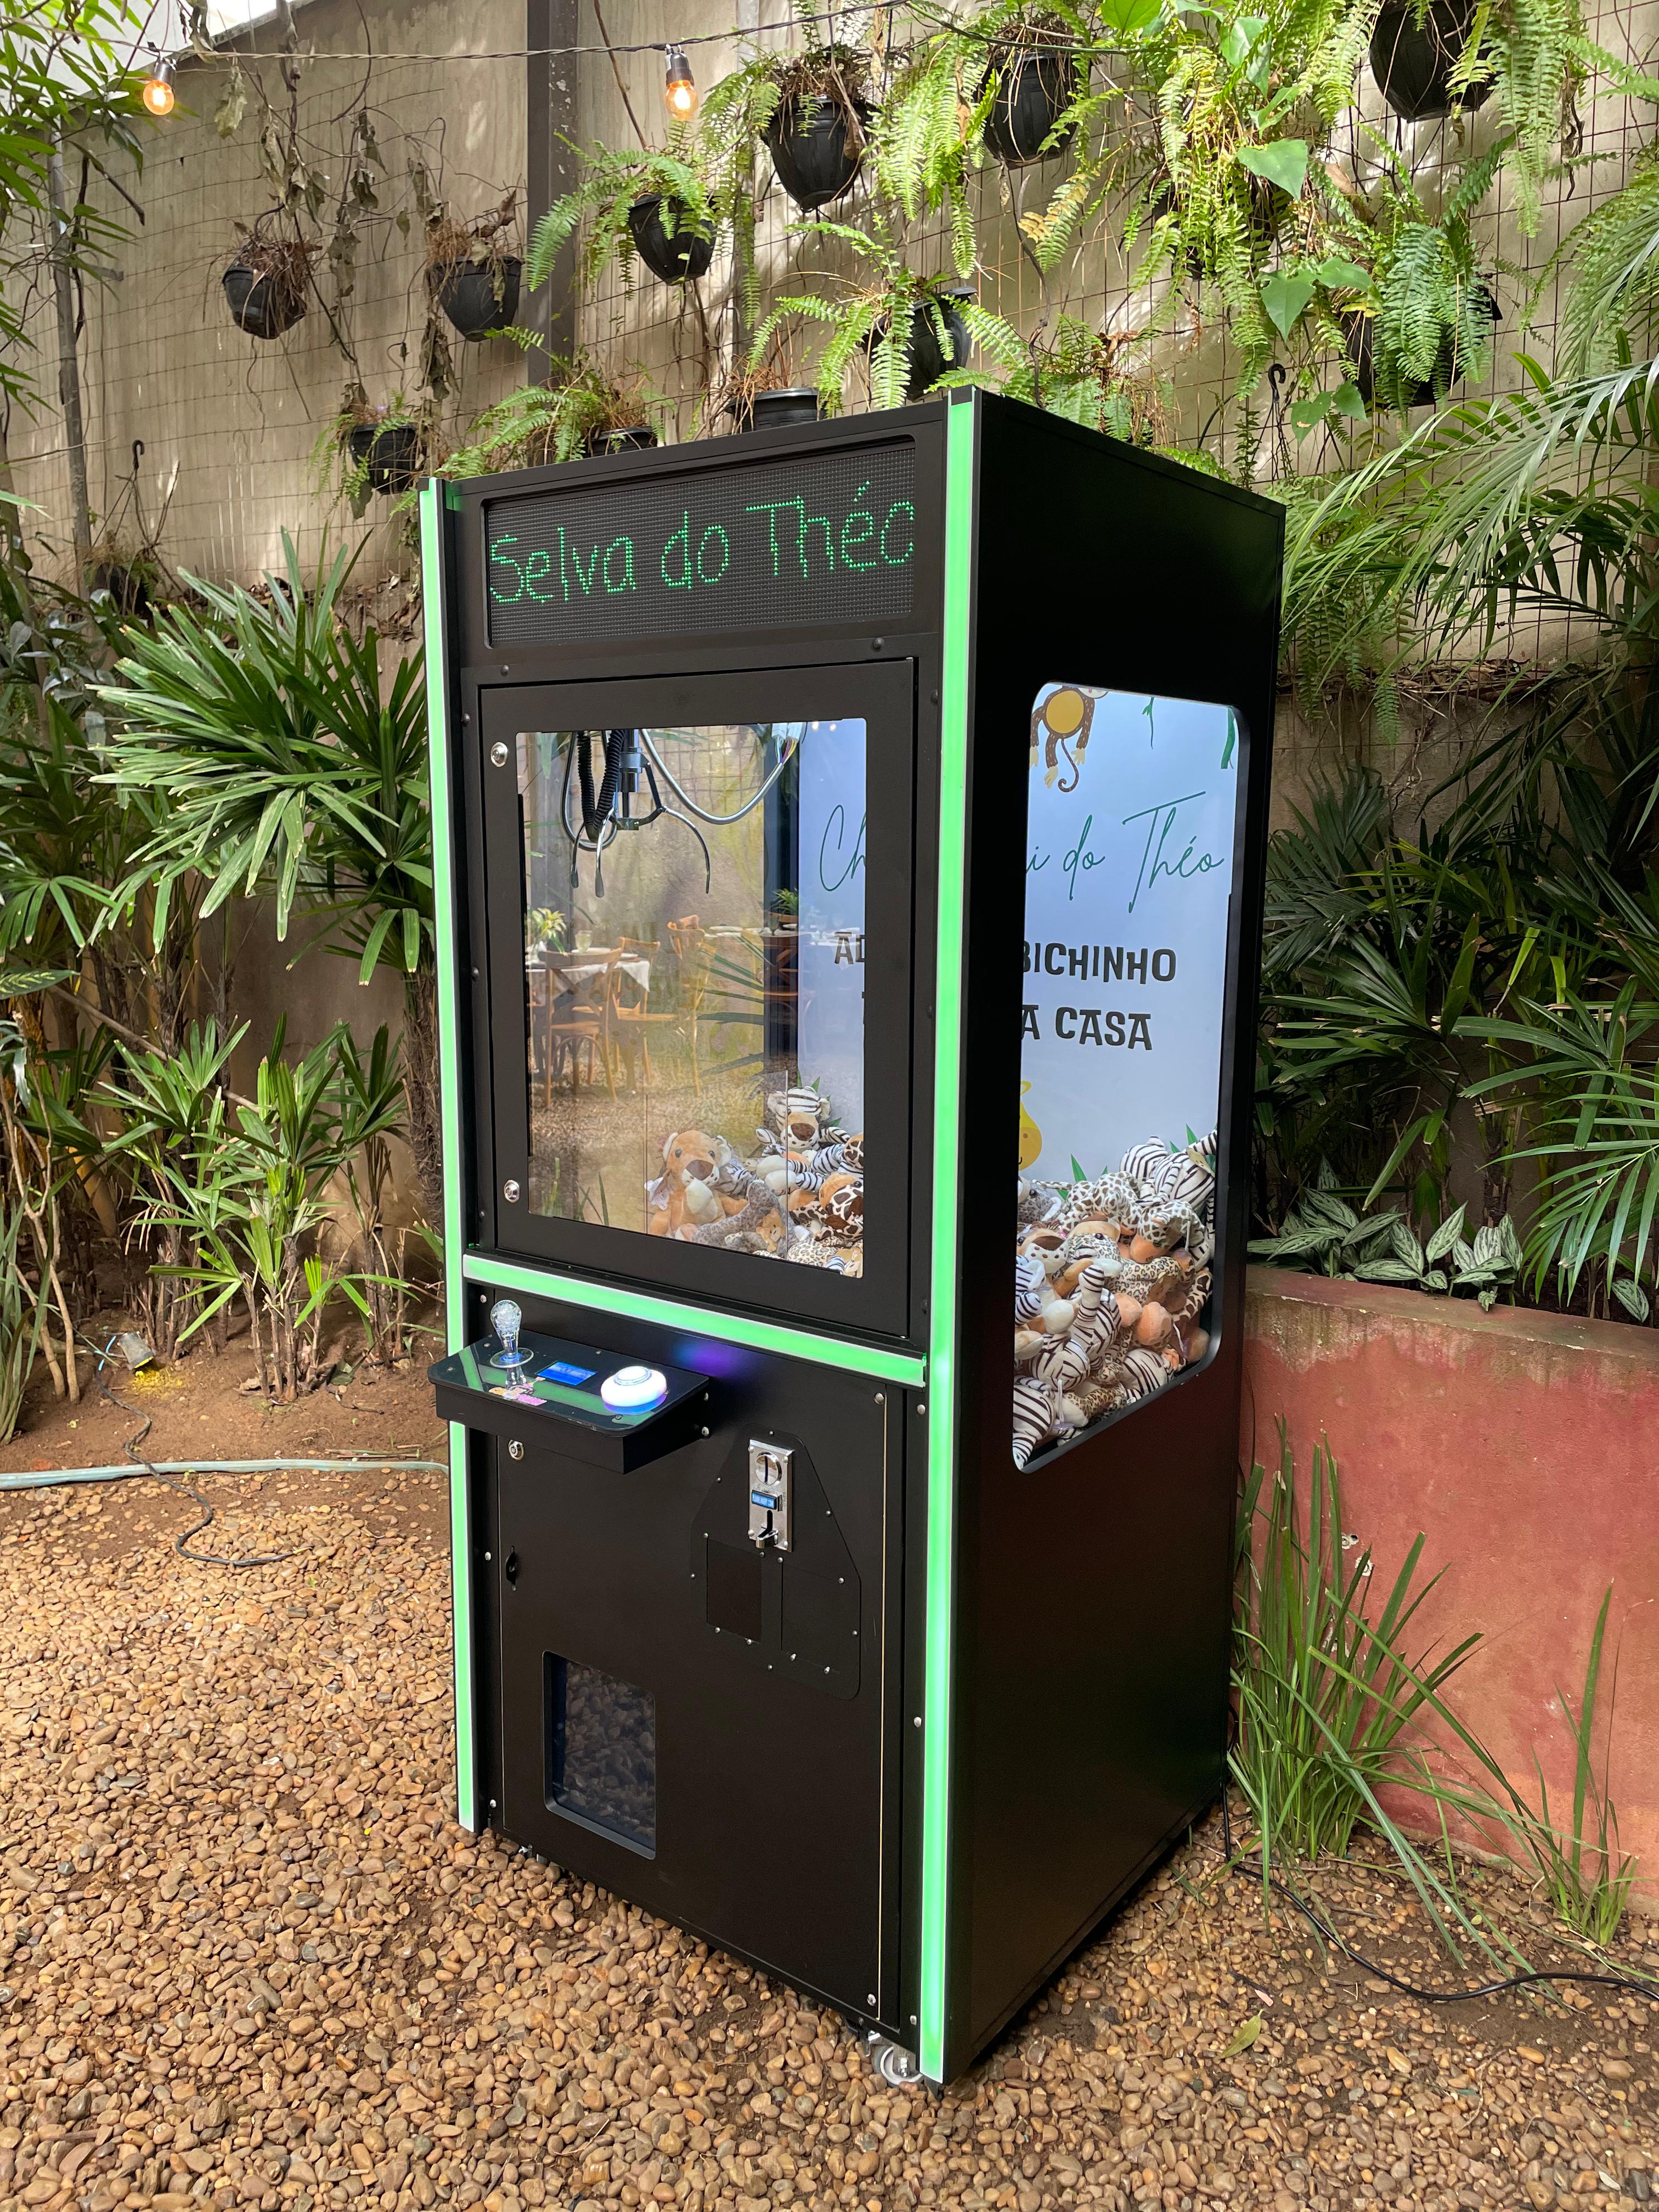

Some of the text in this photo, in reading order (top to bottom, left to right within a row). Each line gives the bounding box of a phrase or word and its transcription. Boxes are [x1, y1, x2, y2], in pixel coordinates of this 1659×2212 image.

[490, 527, 636, 603] Selva
[660, 511, 729, 590] do
[1063, 814, 1106, 901] do
[1122, 791, 1224, 914] Théo
[1055, 1006, 1153, 1051] CASA
